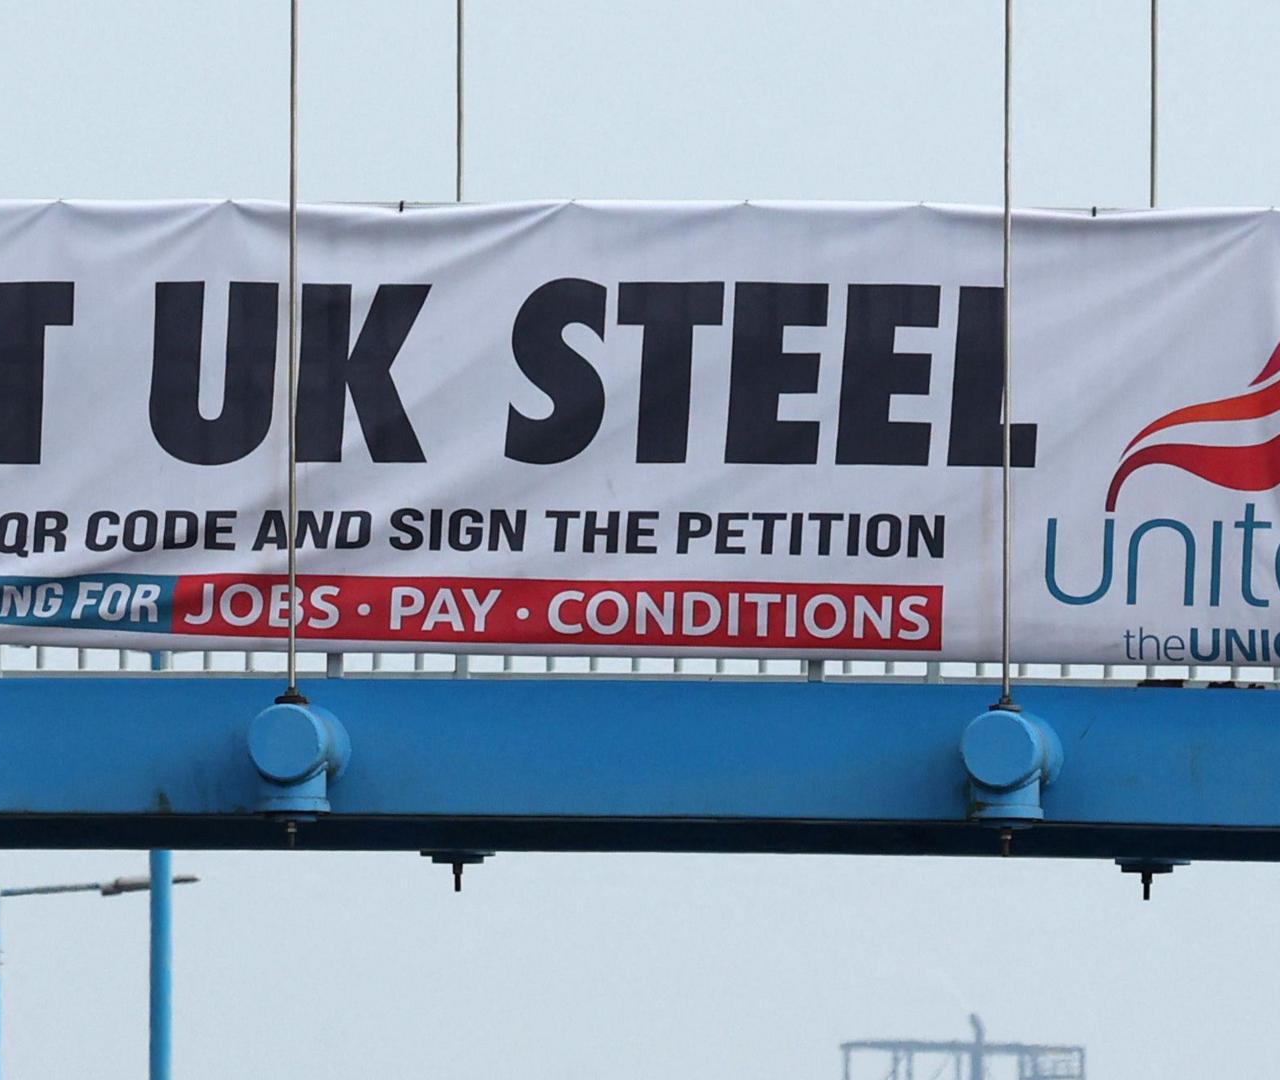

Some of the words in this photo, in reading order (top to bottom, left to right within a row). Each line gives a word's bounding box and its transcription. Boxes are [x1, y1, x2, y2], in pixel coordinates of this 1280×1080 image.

[149, 281, 433, 466] UK
[504, 277, 1038, 469] STEEL
[85, 508, 238, 553] CODE
[251, 509, 373, 552] AND
[388, 507, 528, 553] SIGN
[545, 510, 660, 555] THE
[675, 512, 946, 559] PETITION
[70, 581, 162, 623] FOR
[183, 582, 342, 630] JOBS
[389, 586, 503, 633] PAY
[547, 589, 932, 641] CONDITIONS
